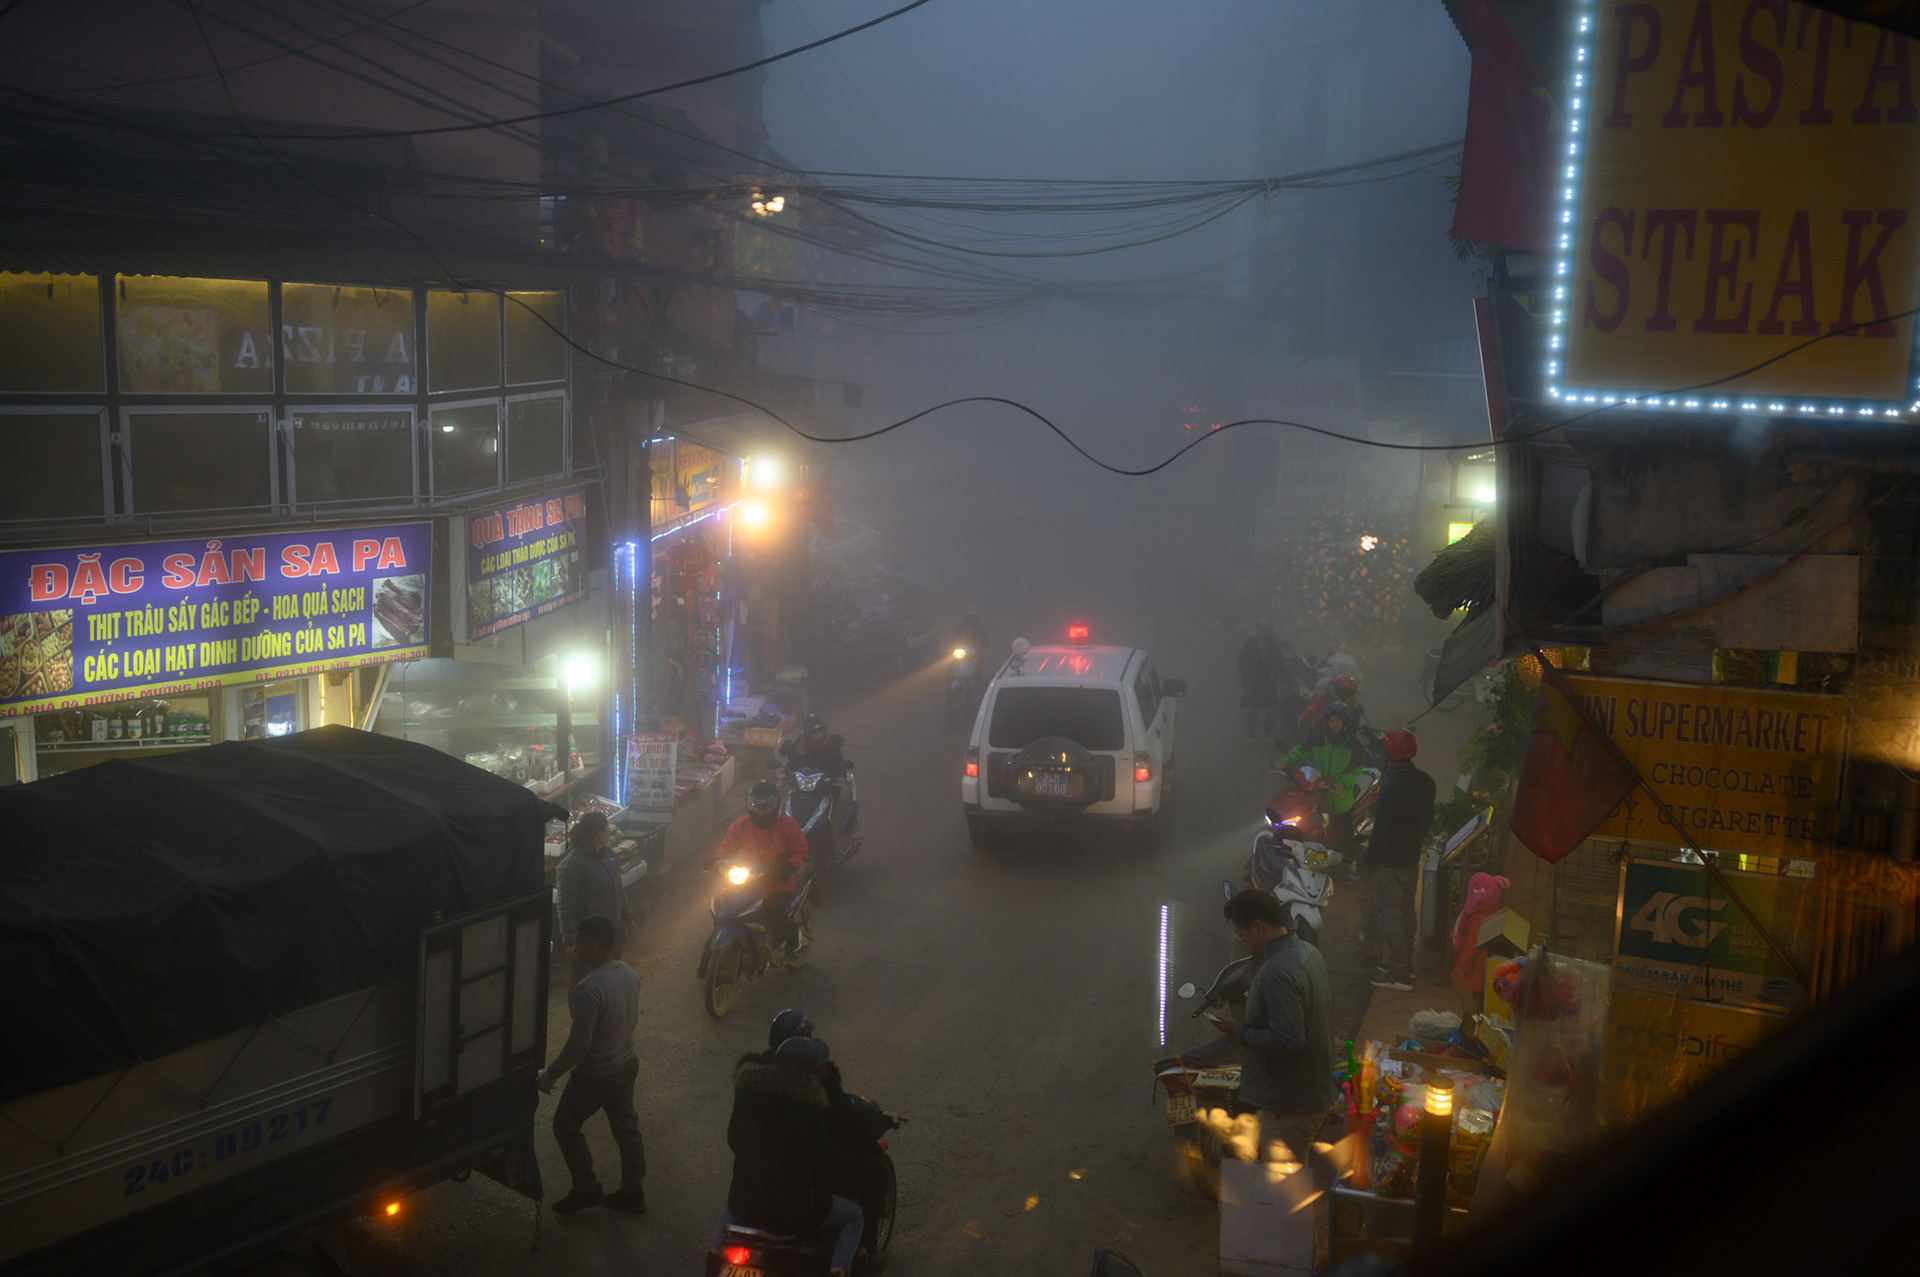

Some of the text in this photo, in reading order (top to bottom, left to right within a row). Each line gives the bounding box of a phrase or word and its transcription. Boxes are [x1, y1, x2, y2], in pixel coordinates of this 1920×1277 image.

[1603, 0, 1920, 130] PASTA
[1583, 205, 1908, 339] STEAK
[472, 493, 581, 549] QUÀ TẶNG SA PA
[28, 536, 407, 605] ĐẶC SẢN SA PA
[481, 553, 495, 576] CÁC
[87, 612, 121, 645] THỊT
[124, 603, 164, 637] TRÂU
[168, 595, 198, 633] SẤY
[201, 596, 229, 630] GÁC
[233, 590, 260, 626] BẾP
[273, 593, 299, 621] HOA
[302, 583, 329, 620] QUẢ
[331, 587, 365, 618] SẠCH
[84, 621, 366, 683] CÁC LOẠI HẠT DINH DƯỠNG CỦA SA PA
[23, 700, 56, 716] NHÀ
[195, 678, 222, 692] HOA
[275, 667, 303, 679] 0913
[307, 664, 325, 674] 801
[1624, 697, 1830, 754] SUPERMARKET
[1651, 762, 1813, 799] CHOCOLATE
[1657, 806, 1818, 841] CIGARETTE
[1629, 891, 1728, 949] 4G
